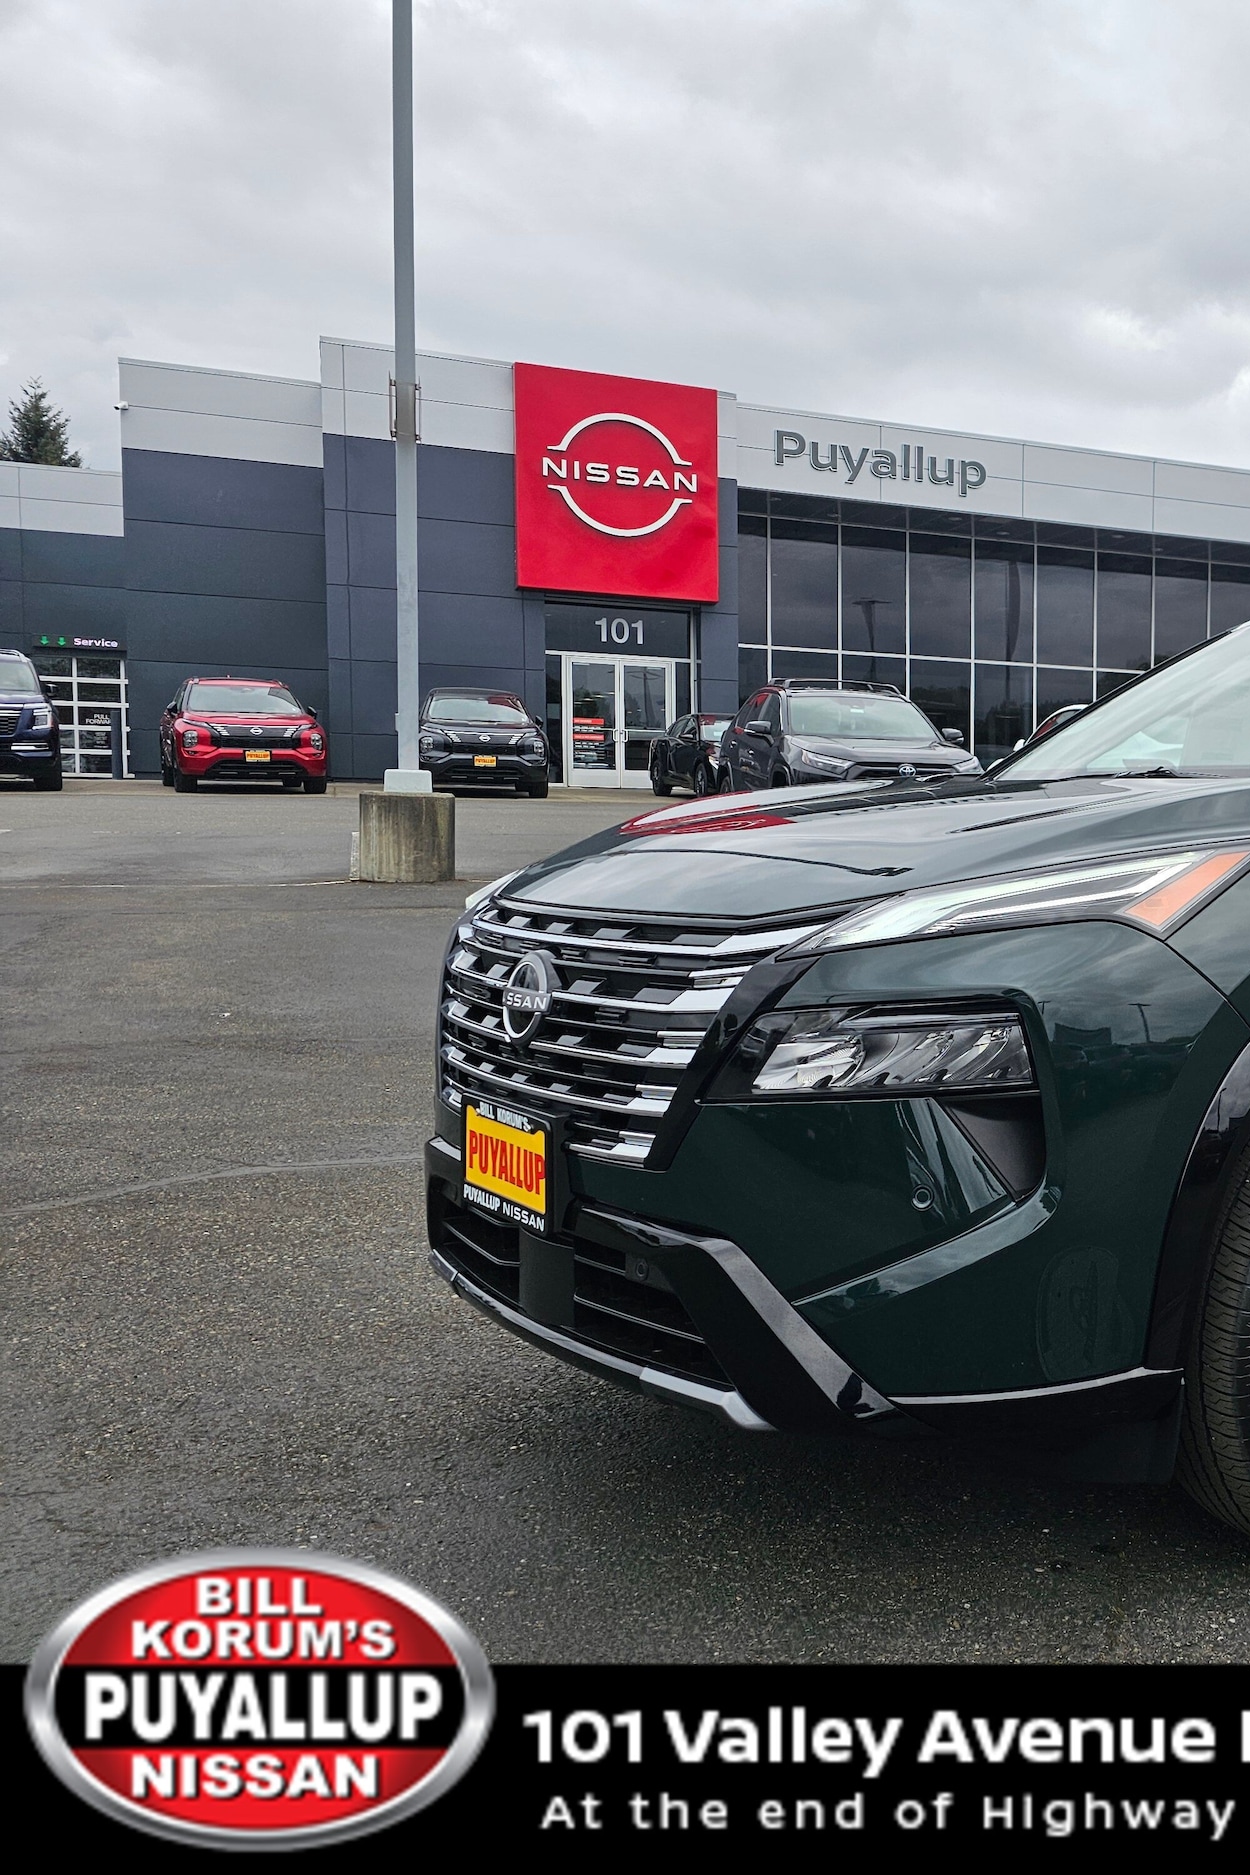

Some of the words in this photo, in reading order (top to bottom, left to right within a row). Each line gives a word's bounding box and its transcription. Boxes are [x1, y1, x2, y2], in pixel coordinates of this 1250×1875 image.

[542, 456, 698, 493] NISSAN
[774, 429, 987, 497] Puyallup
[73, 637, 119, 648] Service
[594, 617, 644, 645] 101
[479, 1101, 495, 1118] BILL
[497, 1106, 531, 1132] KORUM'S
[468, 1129, 546, 1195] PUYALLUP
[463, 1183, 501, 1212] PUYALLUP
[502, 1202, 545, 1232] NISSAN
